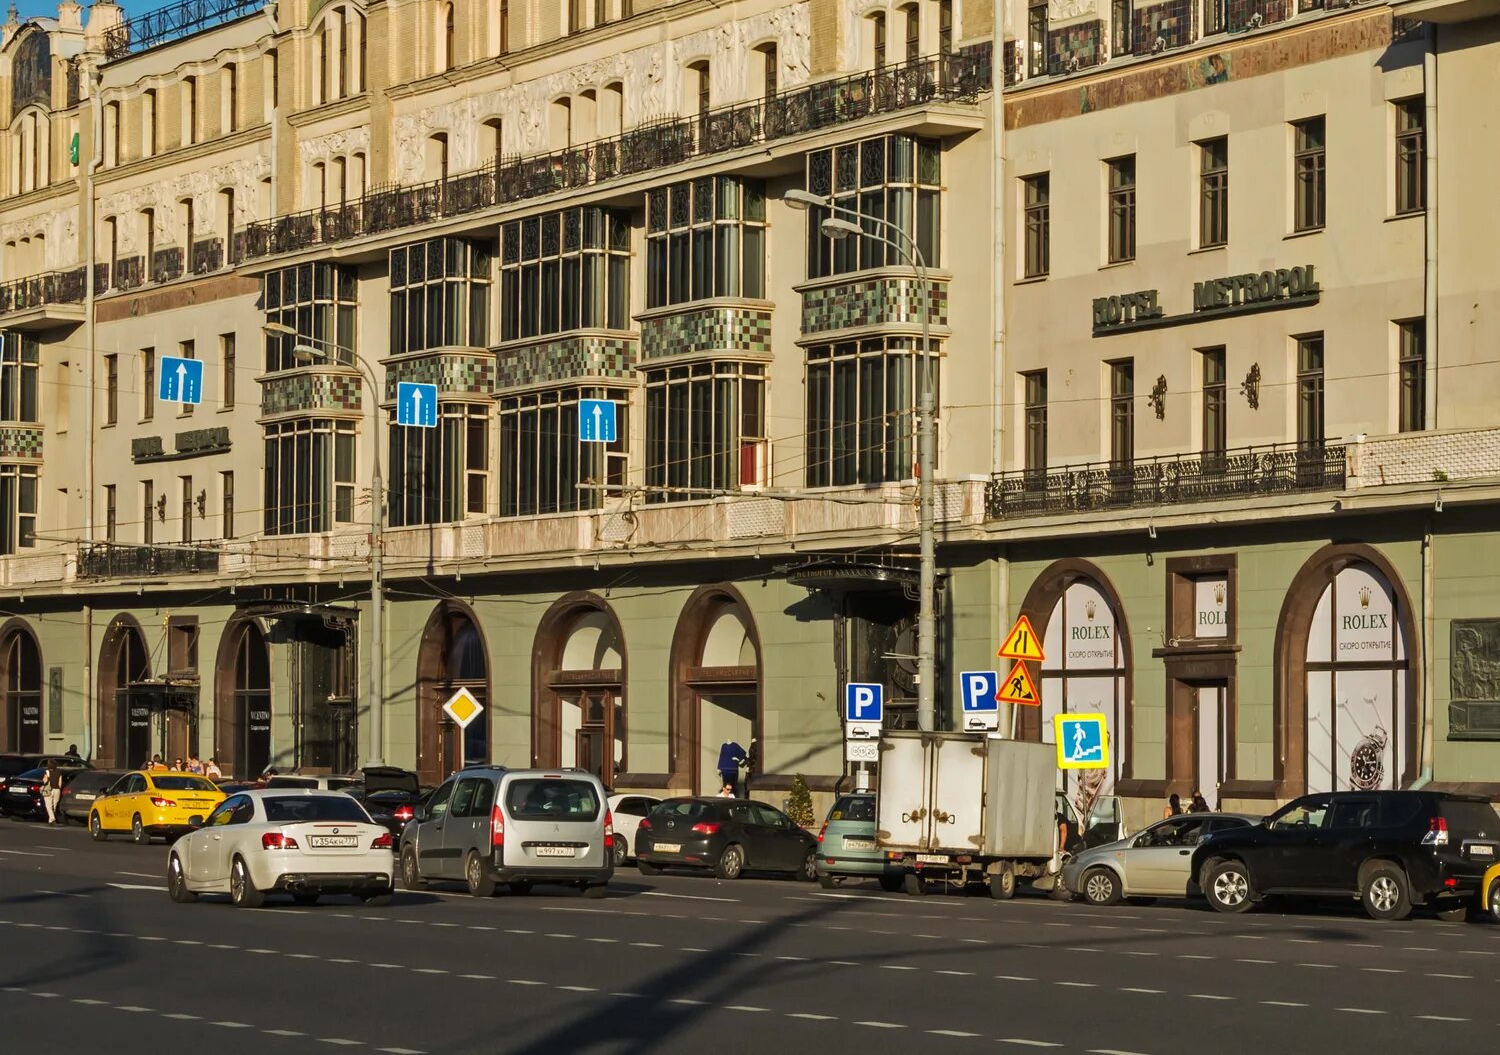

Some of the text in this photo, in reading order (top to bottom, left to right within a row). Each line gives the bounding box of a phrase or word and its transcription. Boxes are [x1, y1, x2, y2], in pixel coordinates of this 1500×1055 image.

[1092, 264, 1321, 326] HOTEL METROPOL
[1343, 614, 1388, 630] ROLEX
[1072, 625, 1110, 640] ROLEX
[1340, 640, 1392, 650] СКОРО ОТКРЫТИЕ
[1069, 649, 1114, 659] СКОРО ОТКРЫТИЕ
[969, 675, 989, 708] P
[855, 687, 874, 718] P
